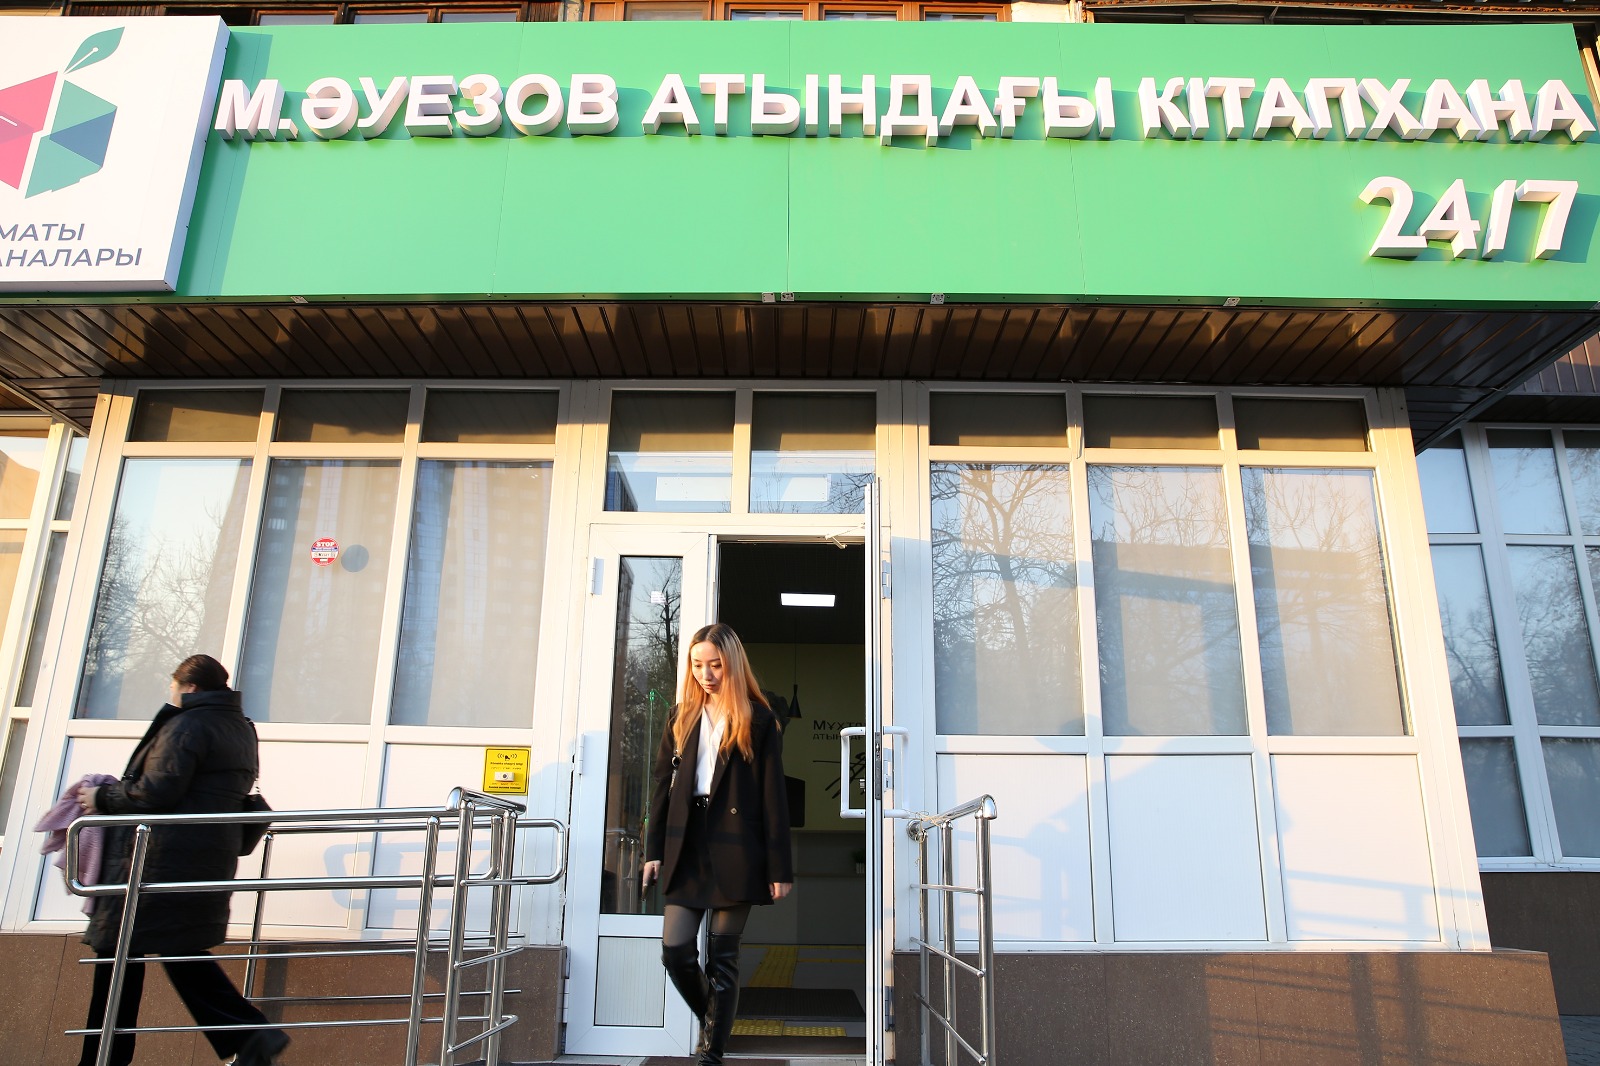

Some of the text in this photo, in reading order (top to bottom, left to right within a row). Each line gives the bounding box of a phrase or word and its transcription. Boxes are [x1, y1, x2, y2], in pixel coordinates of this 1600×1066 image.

[214, 74, 1597, 147] М.ӘУЕЗОВ АТЫНДАҒЫ КІТАПХАНА
[1358, 176, 1579, 260] 24/7
[0, 247, 143, 267] НАЛАРЫ
